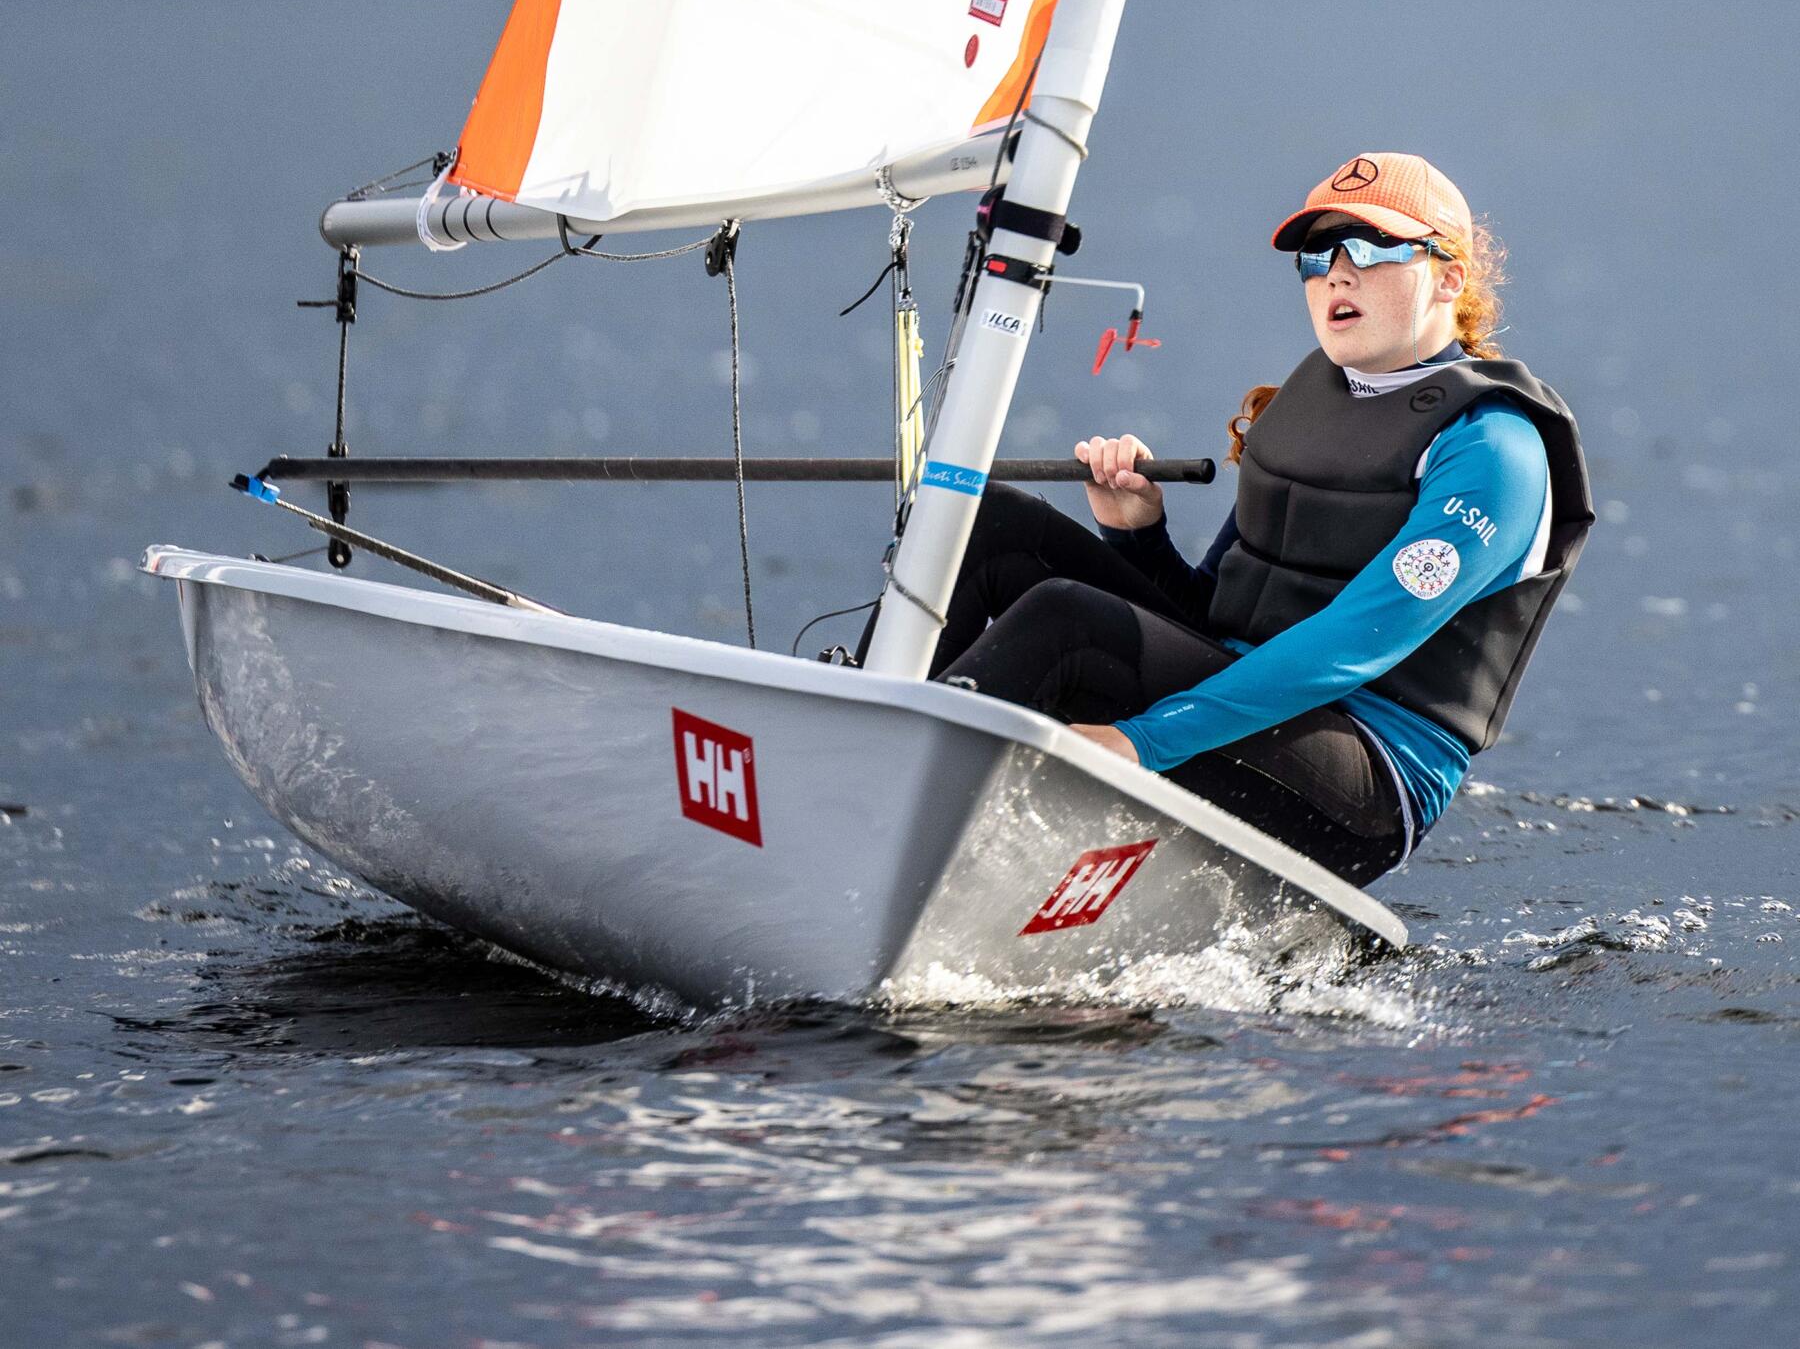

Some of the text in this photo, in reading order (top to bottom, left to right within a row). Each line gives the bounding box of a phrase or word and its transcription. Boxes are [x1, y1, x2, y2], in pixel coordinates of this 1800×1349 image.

[989, 312, 1020, 331] ILCA
[1350, 379, 1380, 394] SAIL
[1443, 496, 1497, 547] U-SAIL
[683, 730, 749, 822] HH
[1040, 855, 1139, 919] HH
